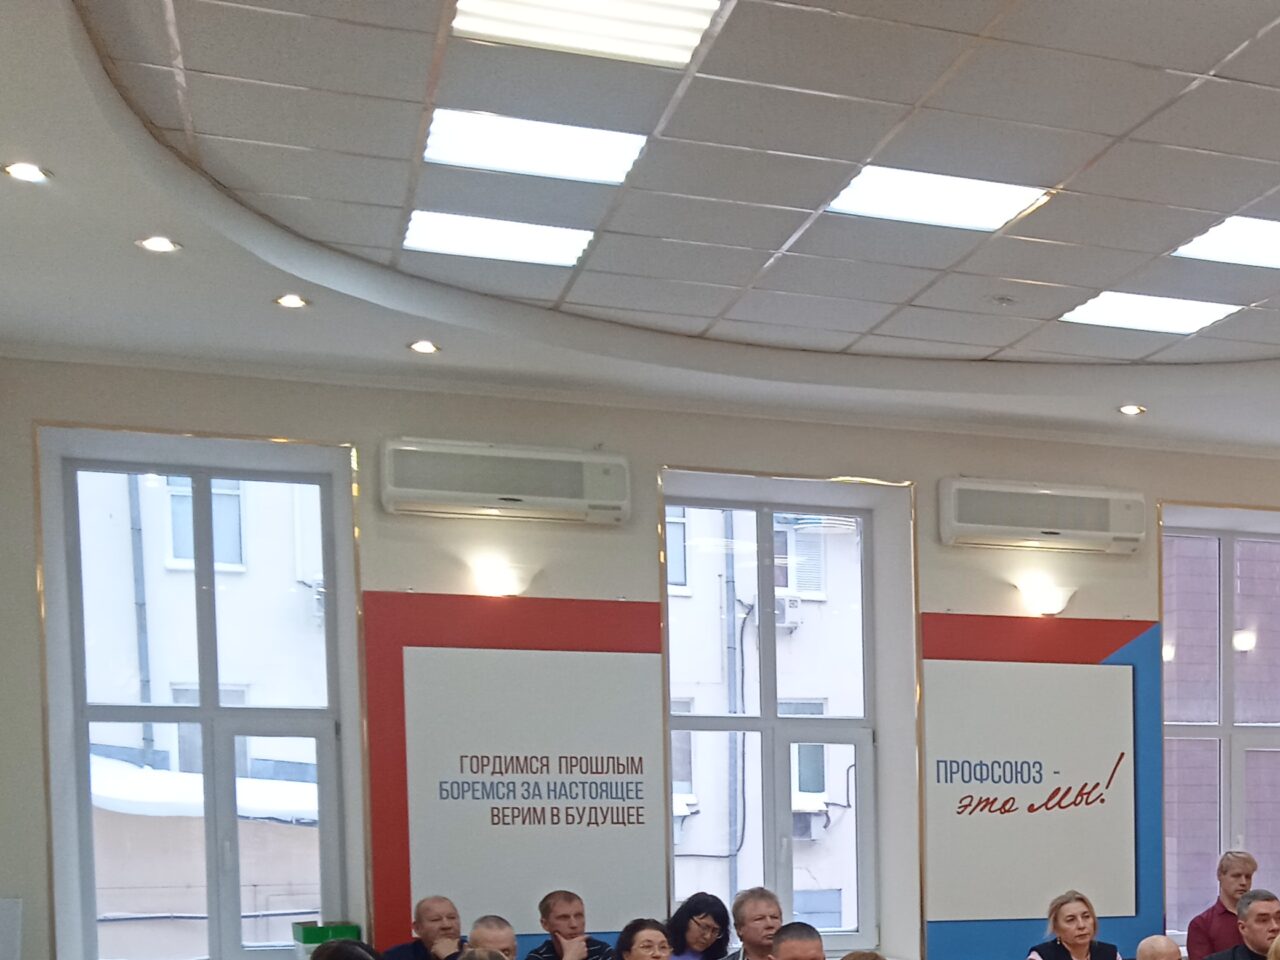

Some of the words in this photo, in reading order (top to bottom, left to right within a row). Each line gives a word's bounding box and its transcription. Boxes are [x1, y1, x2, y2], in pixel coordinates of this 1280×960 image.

[459, 755, 550, 776] ГОРДИМСЯ
[558, 756, 644, 775] ПРОШЛЫМ
[936, 760, 1043, 784] ПРОФСОЮЗ
[439, 781, 516, 800] БОРЕМСЯ
[521, 781, 542, 800] ЗА
[547, 781, 644, 802] НАСТОЯЩЕЕ
[956, 795, 1019, 815] это
[491, 807, 546, 825] ВЕРИМ
[551, 806, 561, 825] В
[565, 806, 645, 827] БУДУЩЕЕ
